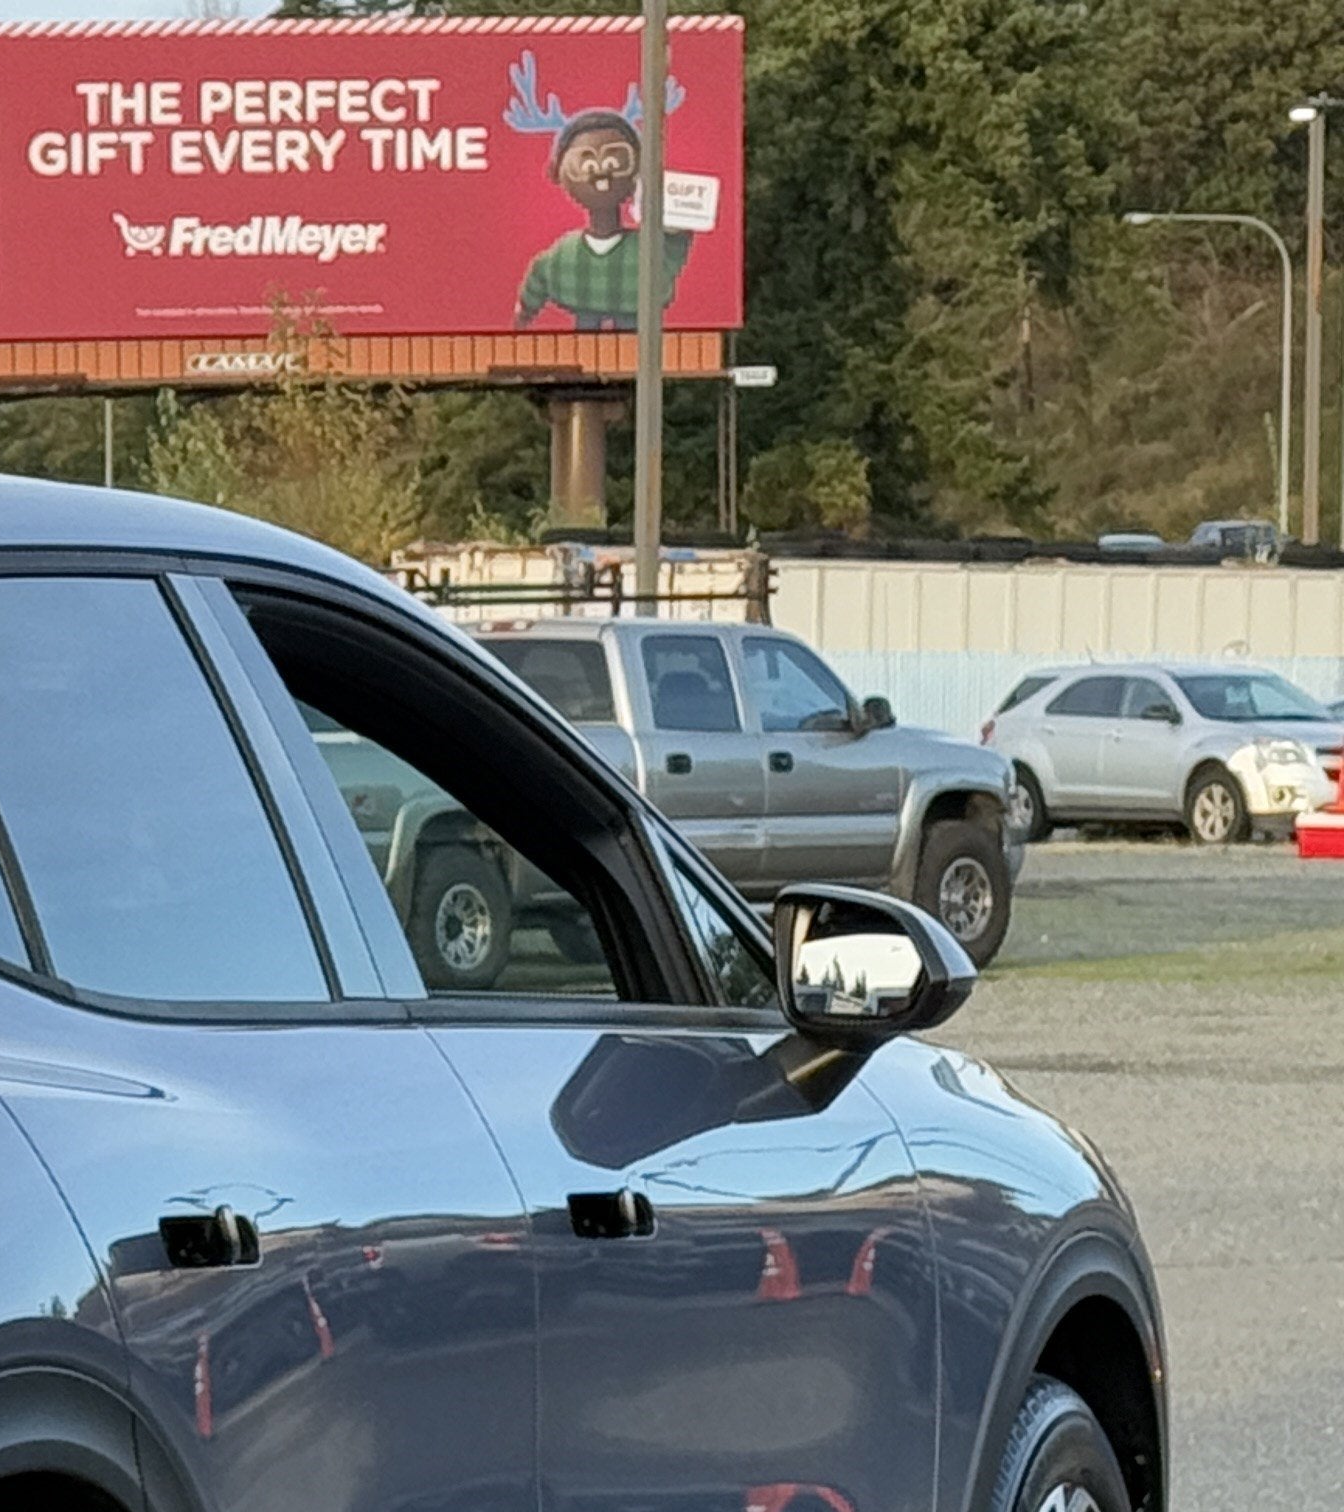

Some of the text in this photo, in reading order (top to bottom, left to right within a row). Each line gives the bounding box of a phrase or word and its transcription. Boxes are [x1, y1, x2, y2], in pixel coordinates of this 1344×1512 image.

[76, 79, 441, 126] THE PERFECT
[28, 127, 490, 176] GIFT EVERY TIME
